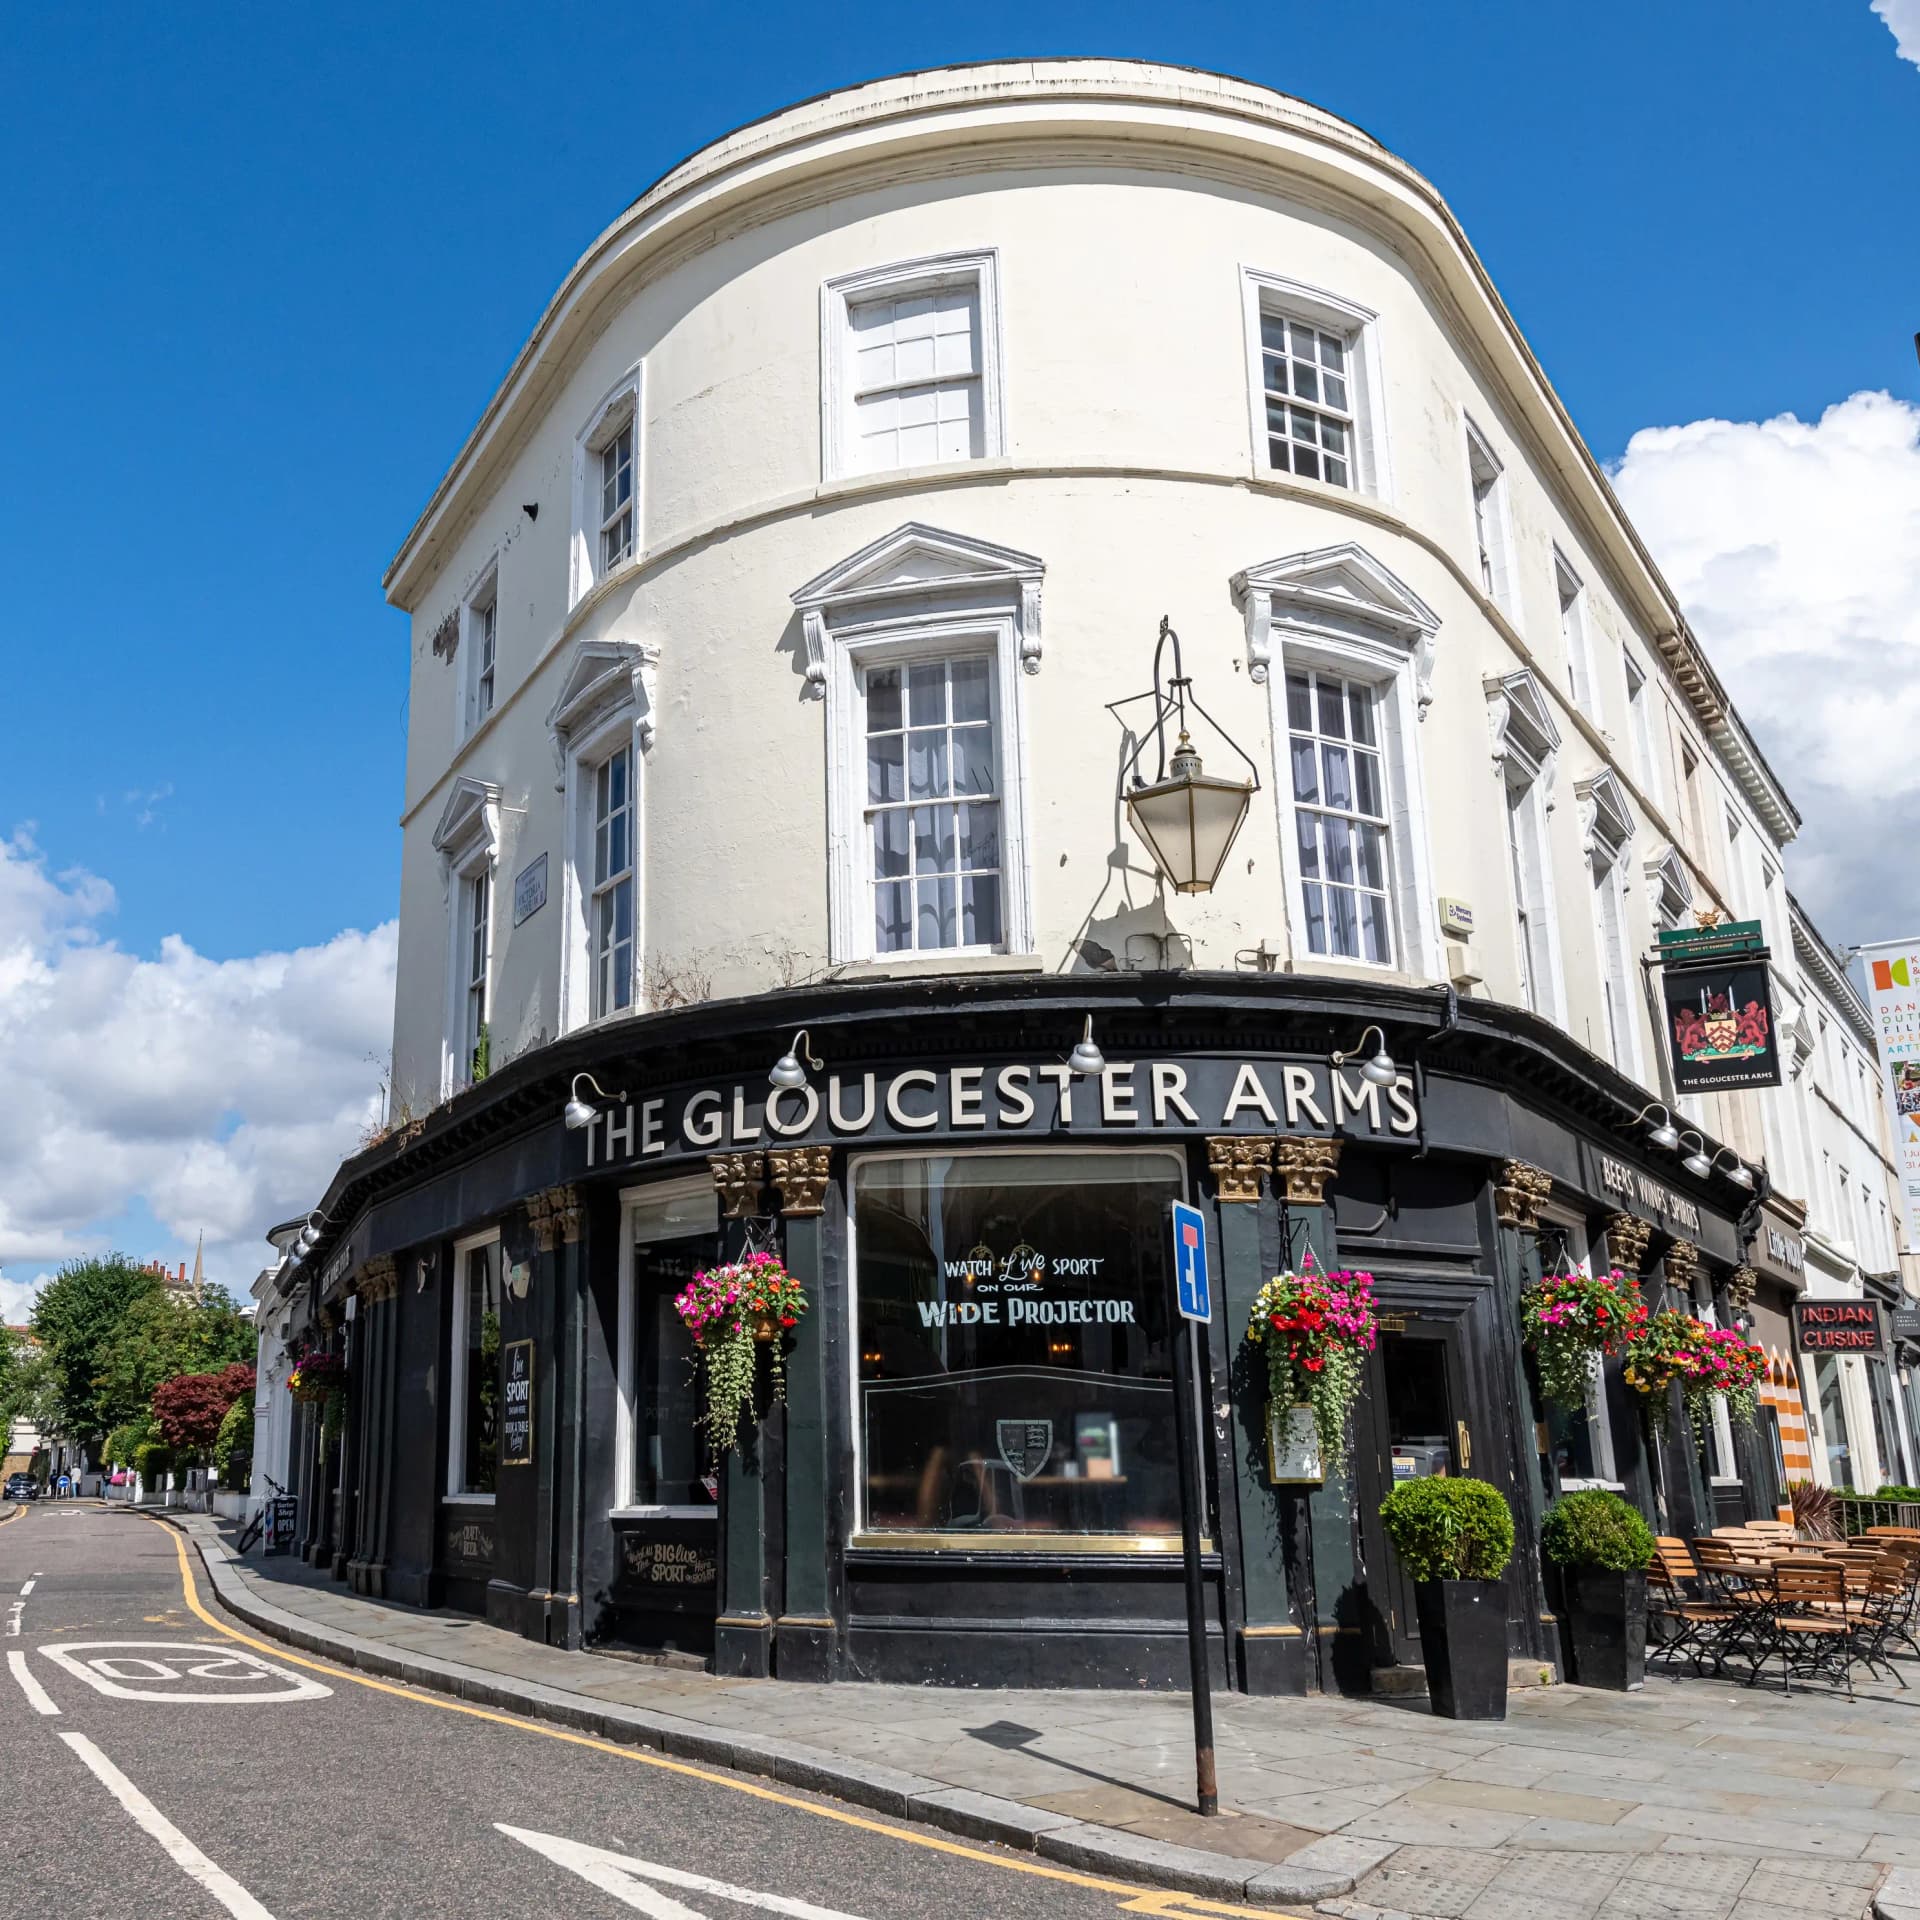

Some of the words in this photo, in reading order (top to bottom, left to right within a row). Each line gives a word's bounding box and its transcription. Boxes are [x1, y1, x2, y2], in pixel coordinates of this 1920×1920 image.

[1882, 1013, 1920, 1024] OUT
[1884, 1022, 1920, 1034] FIL
[1886, 1033, 1920, 1044] OPE
[1683, 1078, 1698, 1086] THE
[1700, 1073, 1749, 1084] GLOUCESTER
[1751, 1071, 1773, 1080] ARMS
[581, 1098, 665, 1166] THE
[683, 1063, 1199, 1145] GLOUCESTER
[1223, 1064, 1418, 1133] ARMS
[1602, 1156, 1634, 1198] BEERS
[1637, 1175, 1668, 1214] WINES
[1670, 1194, 1700, 1231] SPIRITS
[944, 1259, 992, 1278] WATCH
[998, 1253, 1045, 1281] Live
[1052, 1258, 1104, 1276] SPORT
[977, 1284, 998, 1293] ON
[1003, 1284, 1043, 1292] OUR
[917, 1301, 1001, 1328] WIDE
[1008, 1298, 1136, 1326] PROJECTOR
[1802, 1306, 1873, 1323] INDIAN
[1803, 1331, 1876, 1347] CUISINE
[507, 1381, 529, 1402] SPORT
[277, 1519, 295, 1532] OPEN
[653, 1543, 675, 1562] BIG
[675, 1543, 697, 1564] live
[651, 1563, 687, 1583] SPORT
[87, 1658, 269, 1680] 20
